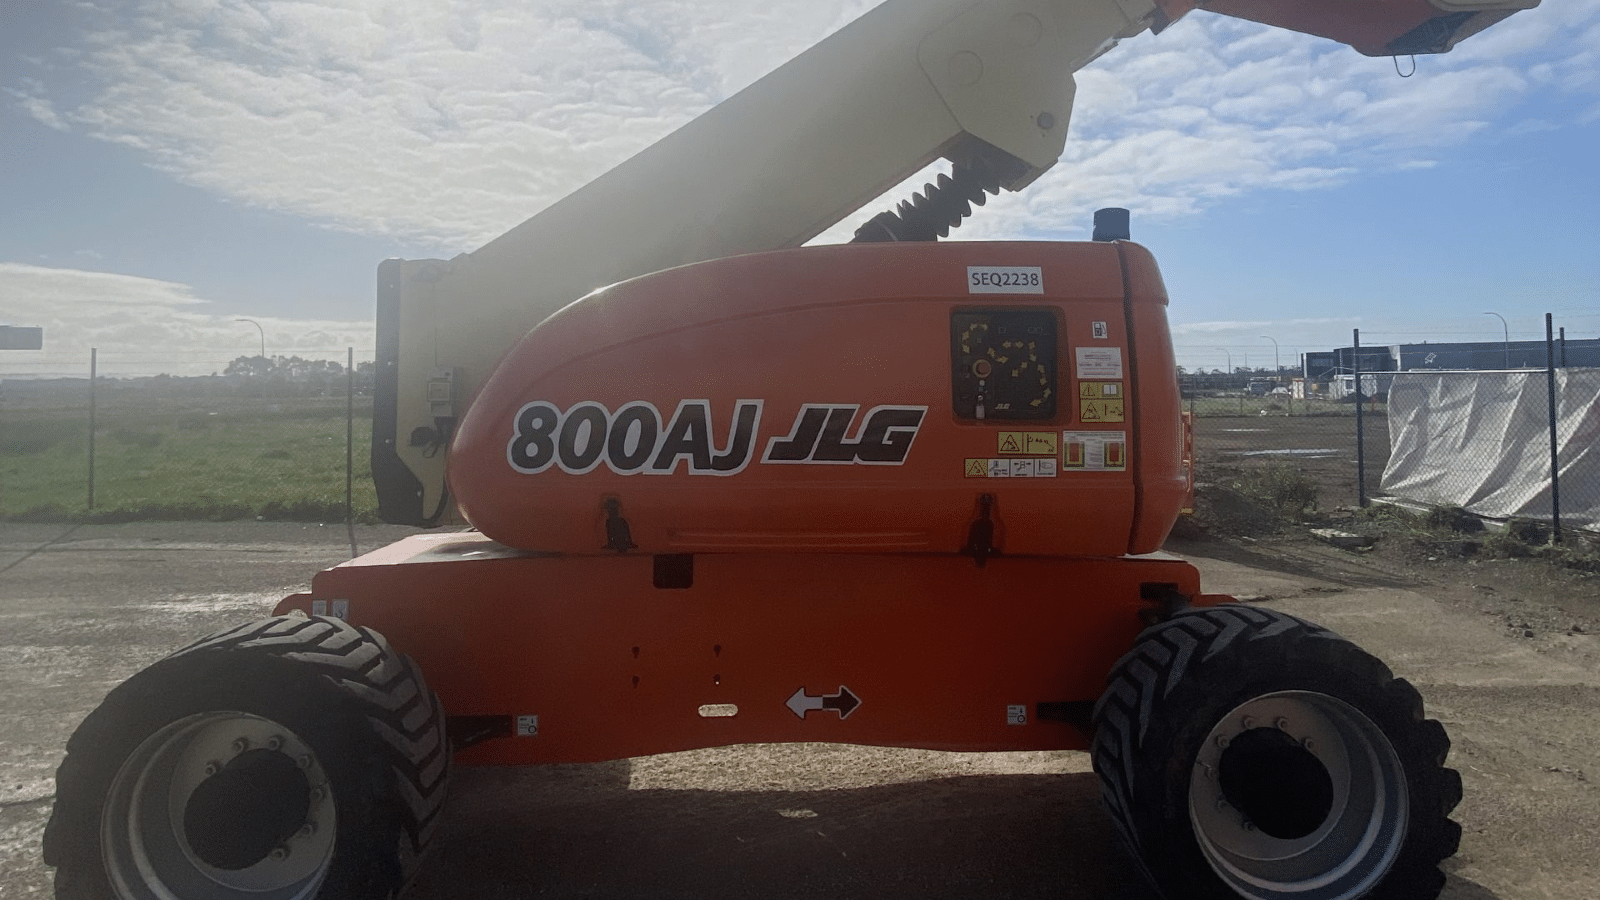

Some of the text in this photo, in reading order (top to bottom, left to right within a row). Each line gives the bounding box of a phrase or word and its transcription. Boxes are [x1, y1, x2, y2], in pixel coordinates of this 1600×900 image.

[971, 272, 1040, 287] SEQ2238
[507, 399, 764, 476] 800AJ
[760, 403, 928, 465] JLG
